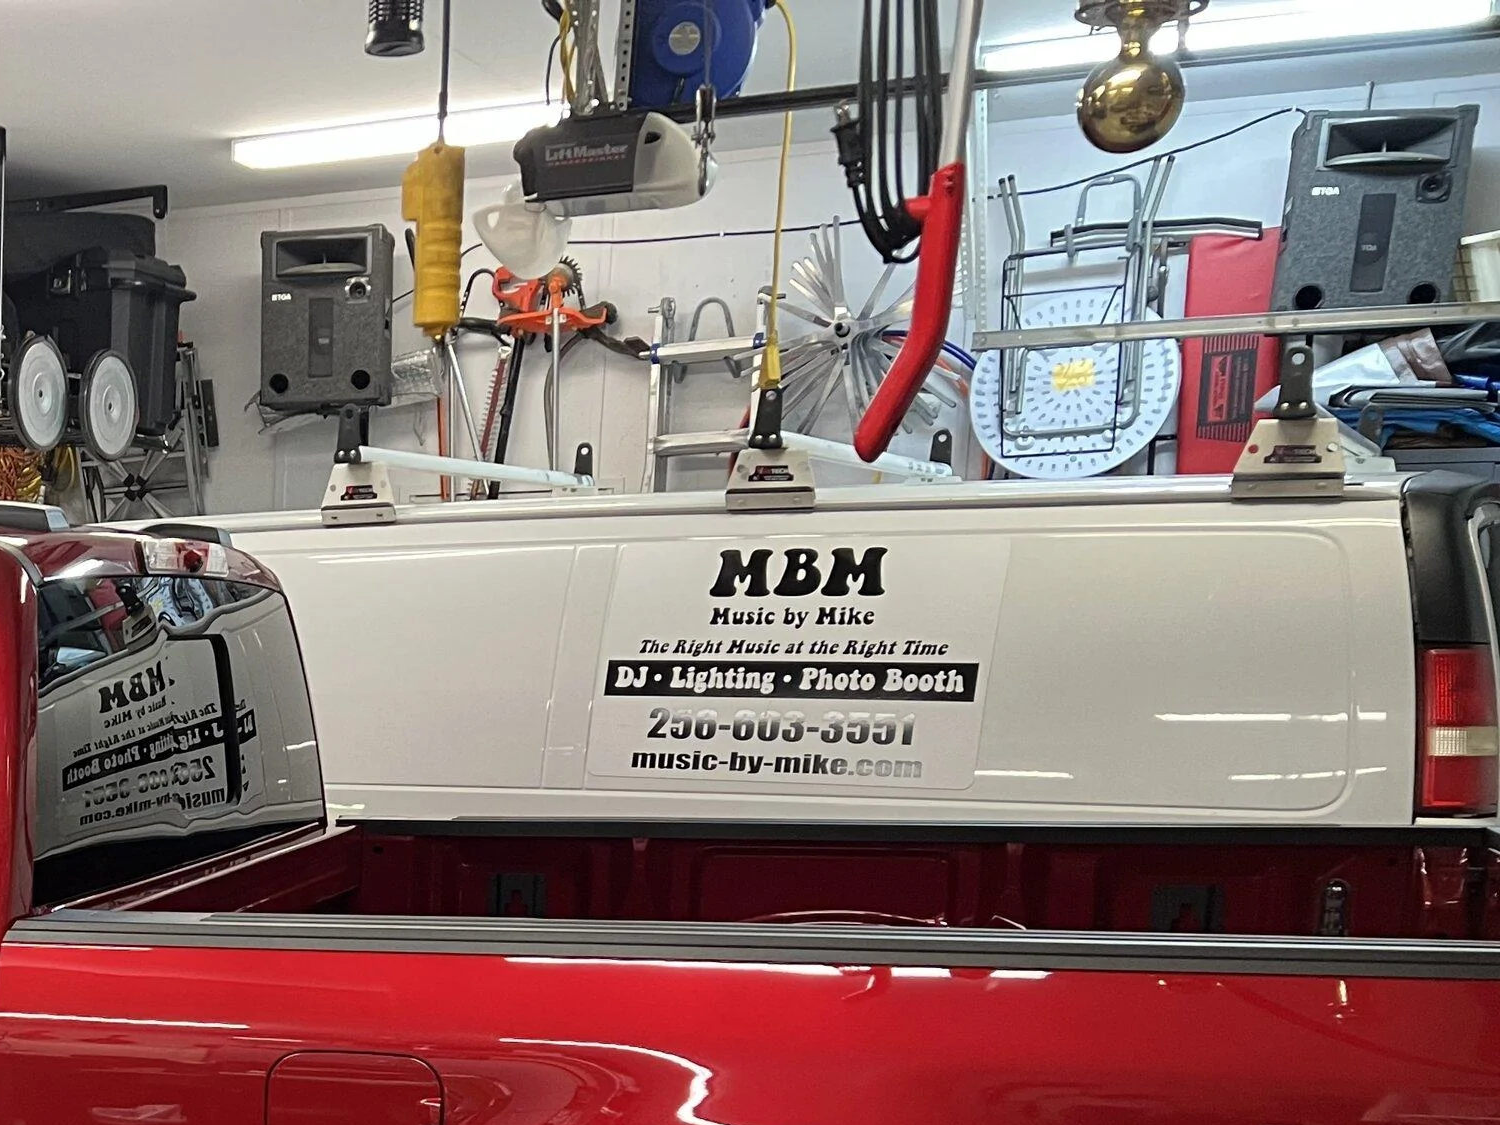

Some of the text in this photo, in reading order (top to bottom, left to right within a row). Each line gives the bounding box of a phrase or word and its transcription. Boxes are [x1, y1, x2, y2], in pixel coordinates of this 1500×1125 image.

[545, 144, 628, 161] LiftMaster
[709, 546, 889, 597] MBM
[710, 606, 875, 628] Music by Mike
[639, 639, 949, 658] The Right Music at the Right Time
[614, 665, 964, 695] DJ Lighting Photo Booth
[646, 707, 917, 746] 256-603-3551
[631, 749, 923, 779] music-by-mike.com
